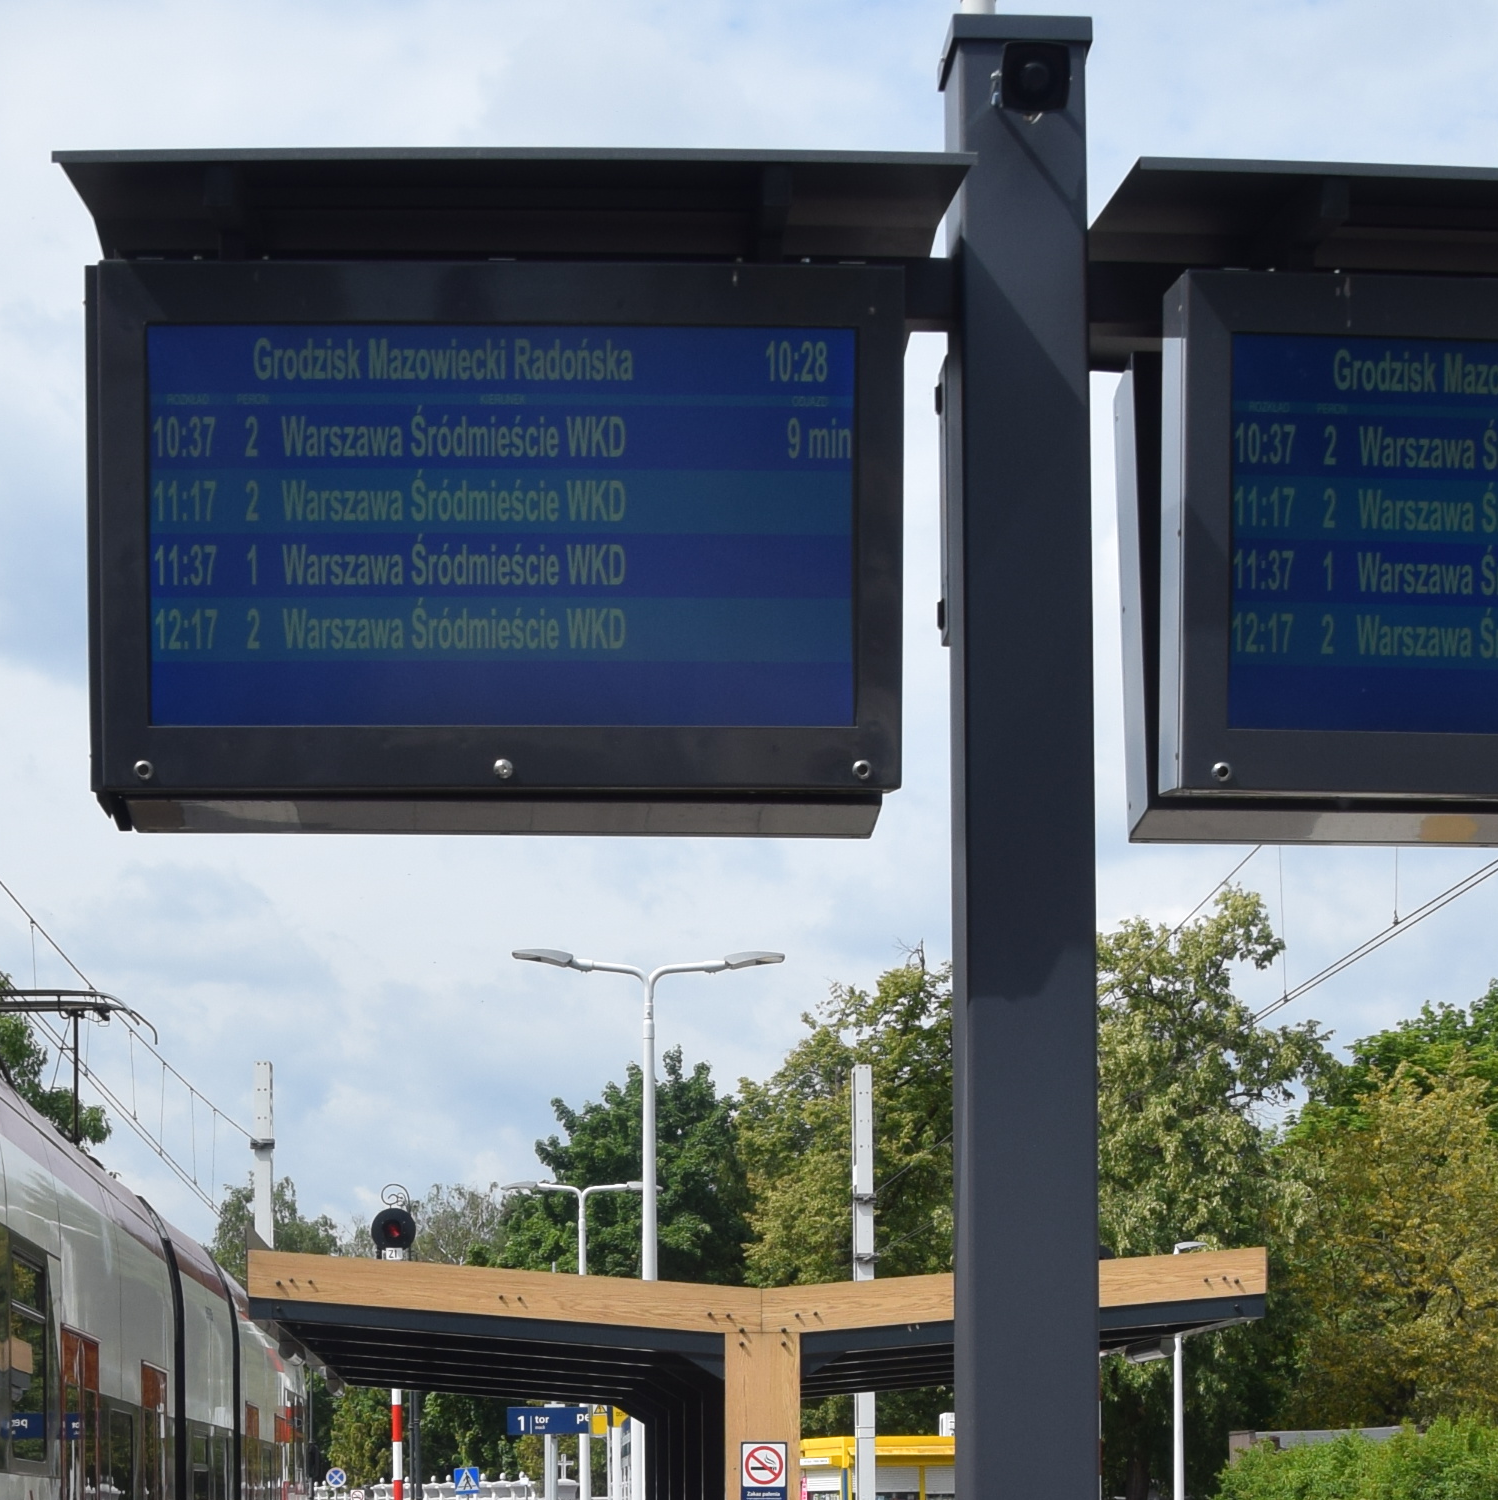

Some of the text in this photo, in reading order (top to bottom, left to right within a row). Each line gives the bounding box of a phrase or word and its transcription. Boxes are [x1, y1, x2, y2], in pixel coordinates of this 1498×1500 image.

[253, 337, 633, 381] Grodzisk Mazowiecki Radońska
[765, 341, 827, 382] 10:28
[1333, 349, 1437, 393] Grodzisk
[153, 405, 851, 458] 10:37 2 Warszawa Śródmieście WKD 9 min
[1235, 422, 1296, 464] 10:37
[1323, 425, 1337, 465] 2
[1359, 425, 1475, 469] Warszawa
[154, 469, 626, 521] 11:17 2 Warszawa Śródmieście WKD
[1234, 485, 1295, 527] 11:17
[1323, 488, 1336, 528] 2
[1358, 488, 1474, 532] Warszawa
[154, 533, 626, 585] 11:37 1 Warszawa Śródmieście WKD
[1233, 549, 1294, 590] 11:37
[1323, 551, 1333, 591] 1
[1357, 552, 1473, 594] Warszawa
[155, 597, 626, 649] 12:17 2 Warszawa Śródmieście WKD
[1232, 612, 1294, 653] 12:17
[1321, 614, 1334, 654] 2
[1356, 614, 1471, 656] Warszawa
[517, 1415, 525, 1431] 1
[535, 1415, 549, 1424] tor
